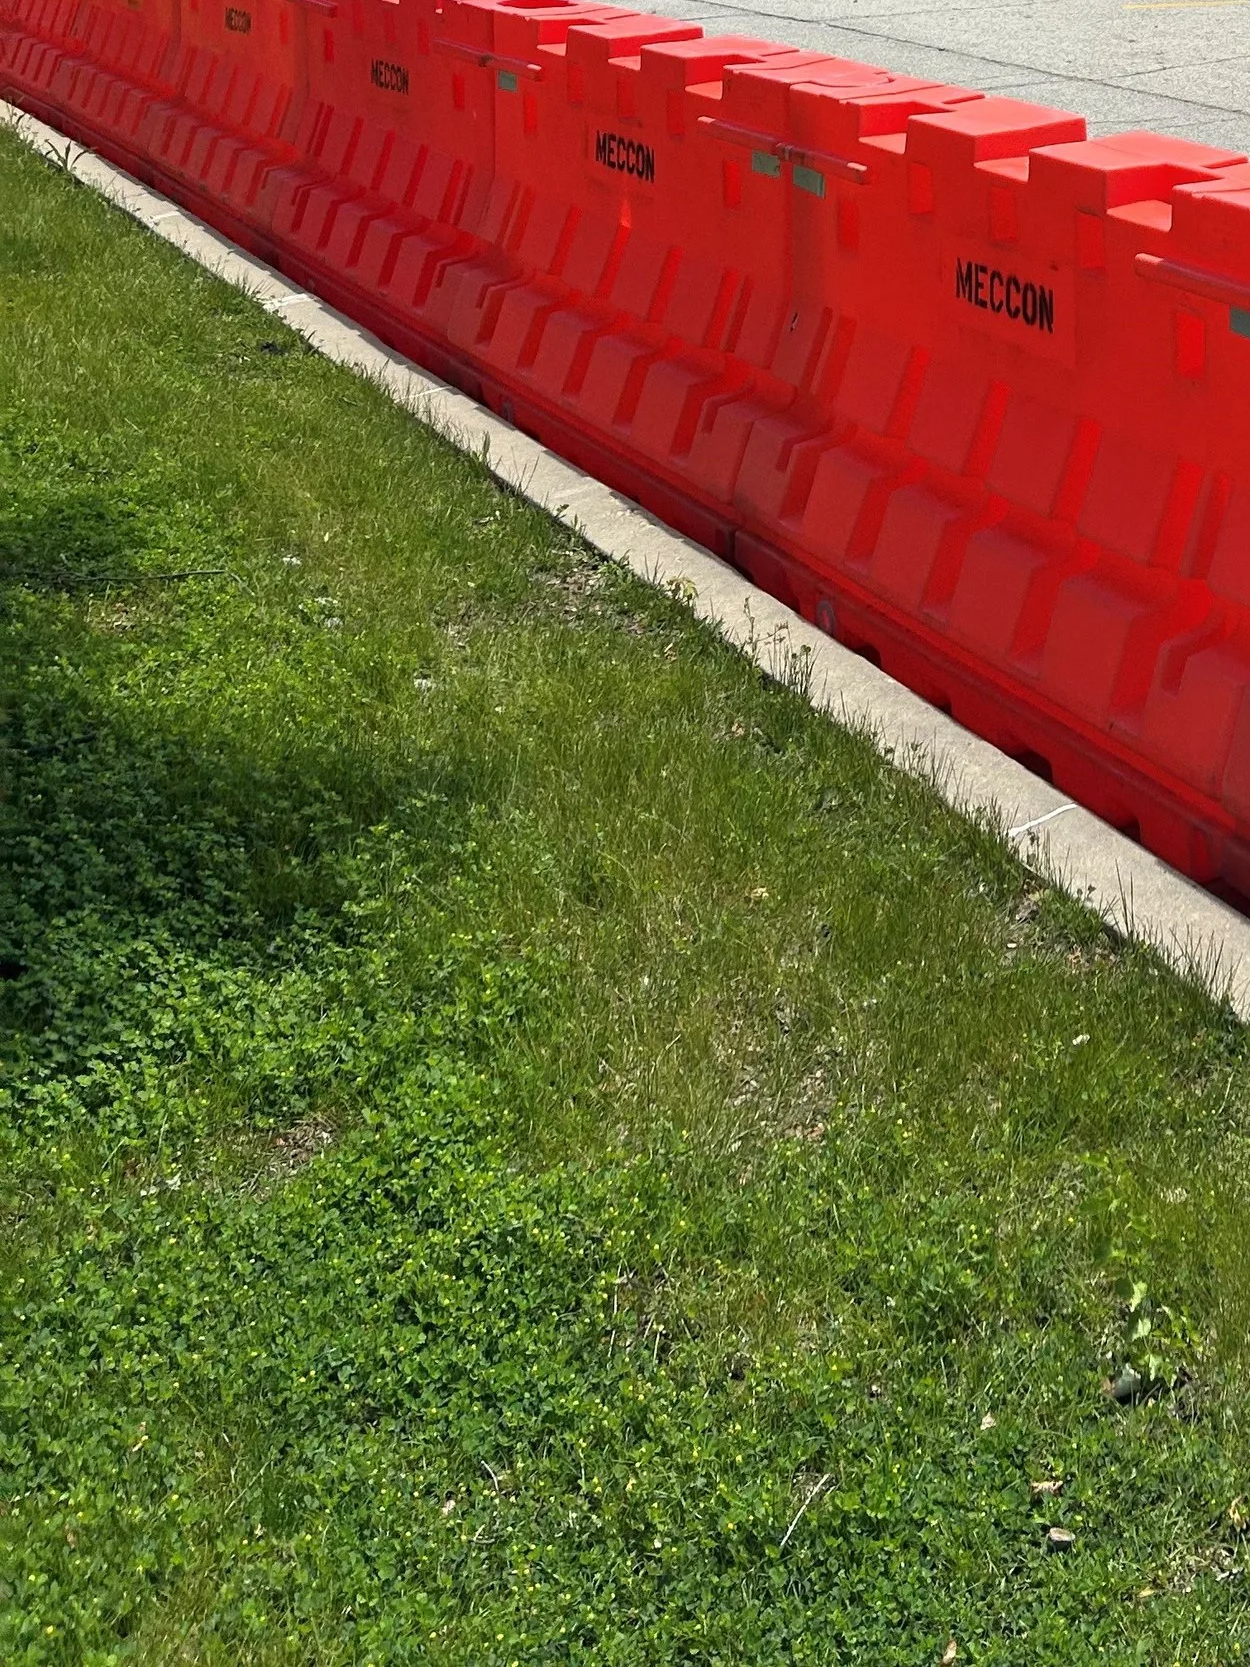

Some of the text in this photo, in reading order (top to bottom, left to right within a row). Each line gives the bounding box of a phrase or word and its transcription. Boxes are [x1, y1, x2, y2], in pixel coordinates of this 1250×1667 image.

[371, 58, 409, 95] MECCON
[596, 130, 655, 184] MECCON
[956, 257, 1054, 335] MECCON
